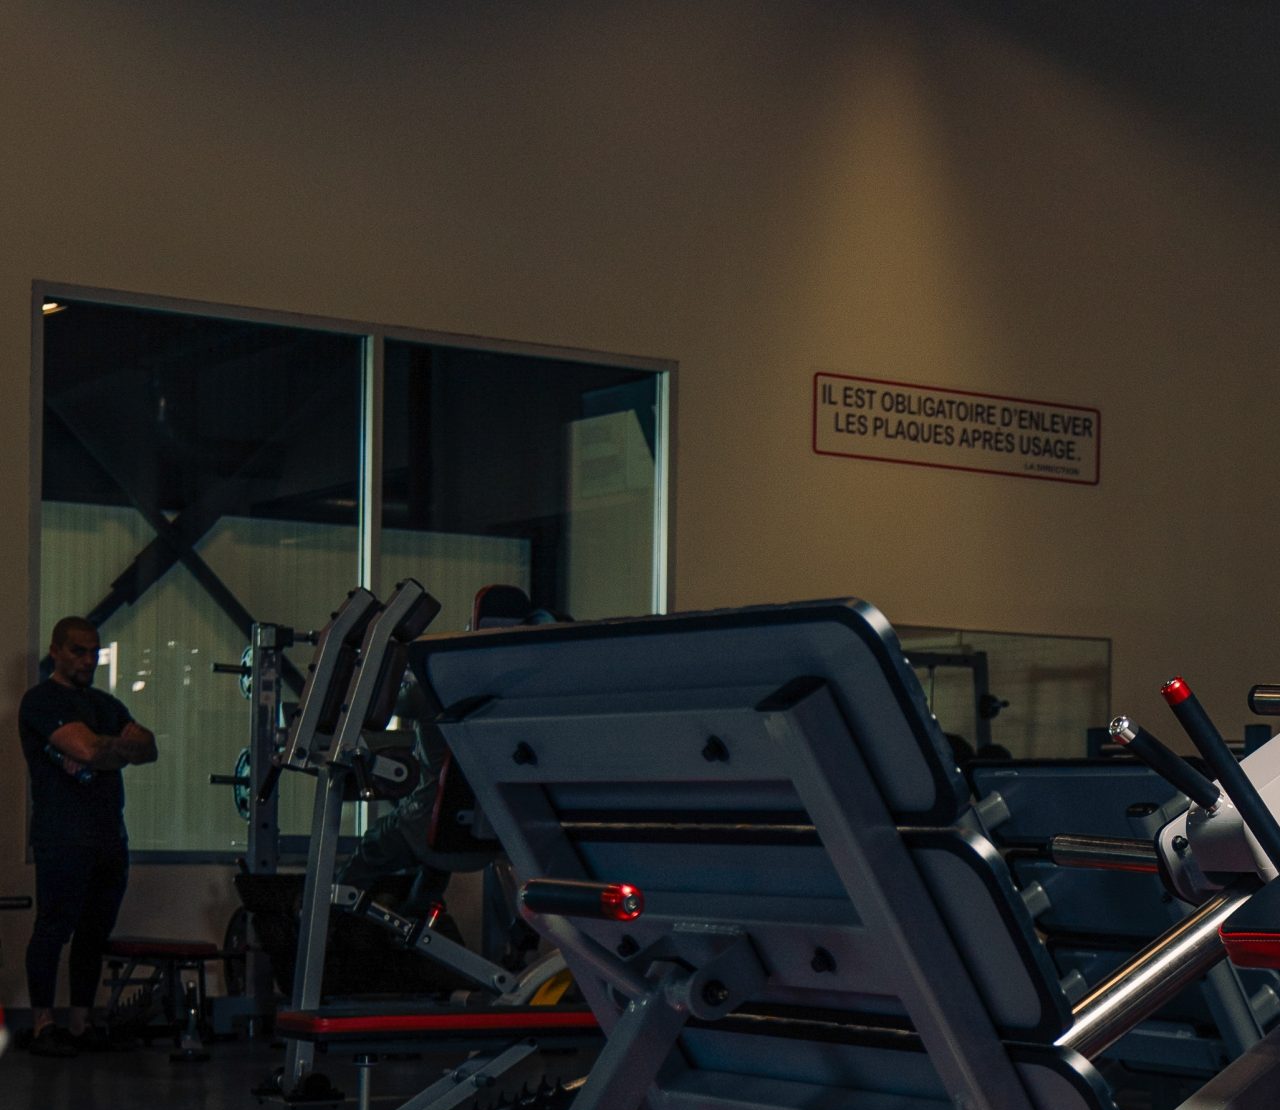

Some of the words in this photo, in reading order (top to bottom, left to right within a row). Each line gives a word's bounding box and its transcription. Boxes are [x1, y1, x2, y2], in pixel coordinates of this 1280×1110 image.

[822, 384, 838, 405] IL
[843, 386, 877, 410] EST
[881, 391, 997, 425] OBLIGATOIRE
[1001, 407, 1093, 438] D'ENLEVER
[835, 412, 868, 435] LES
[873, 416, 954, 446] PLAQUES
[959, 427, 1015, 453] APRÈS
[1019, 435, 1081, 461] USAGE.
